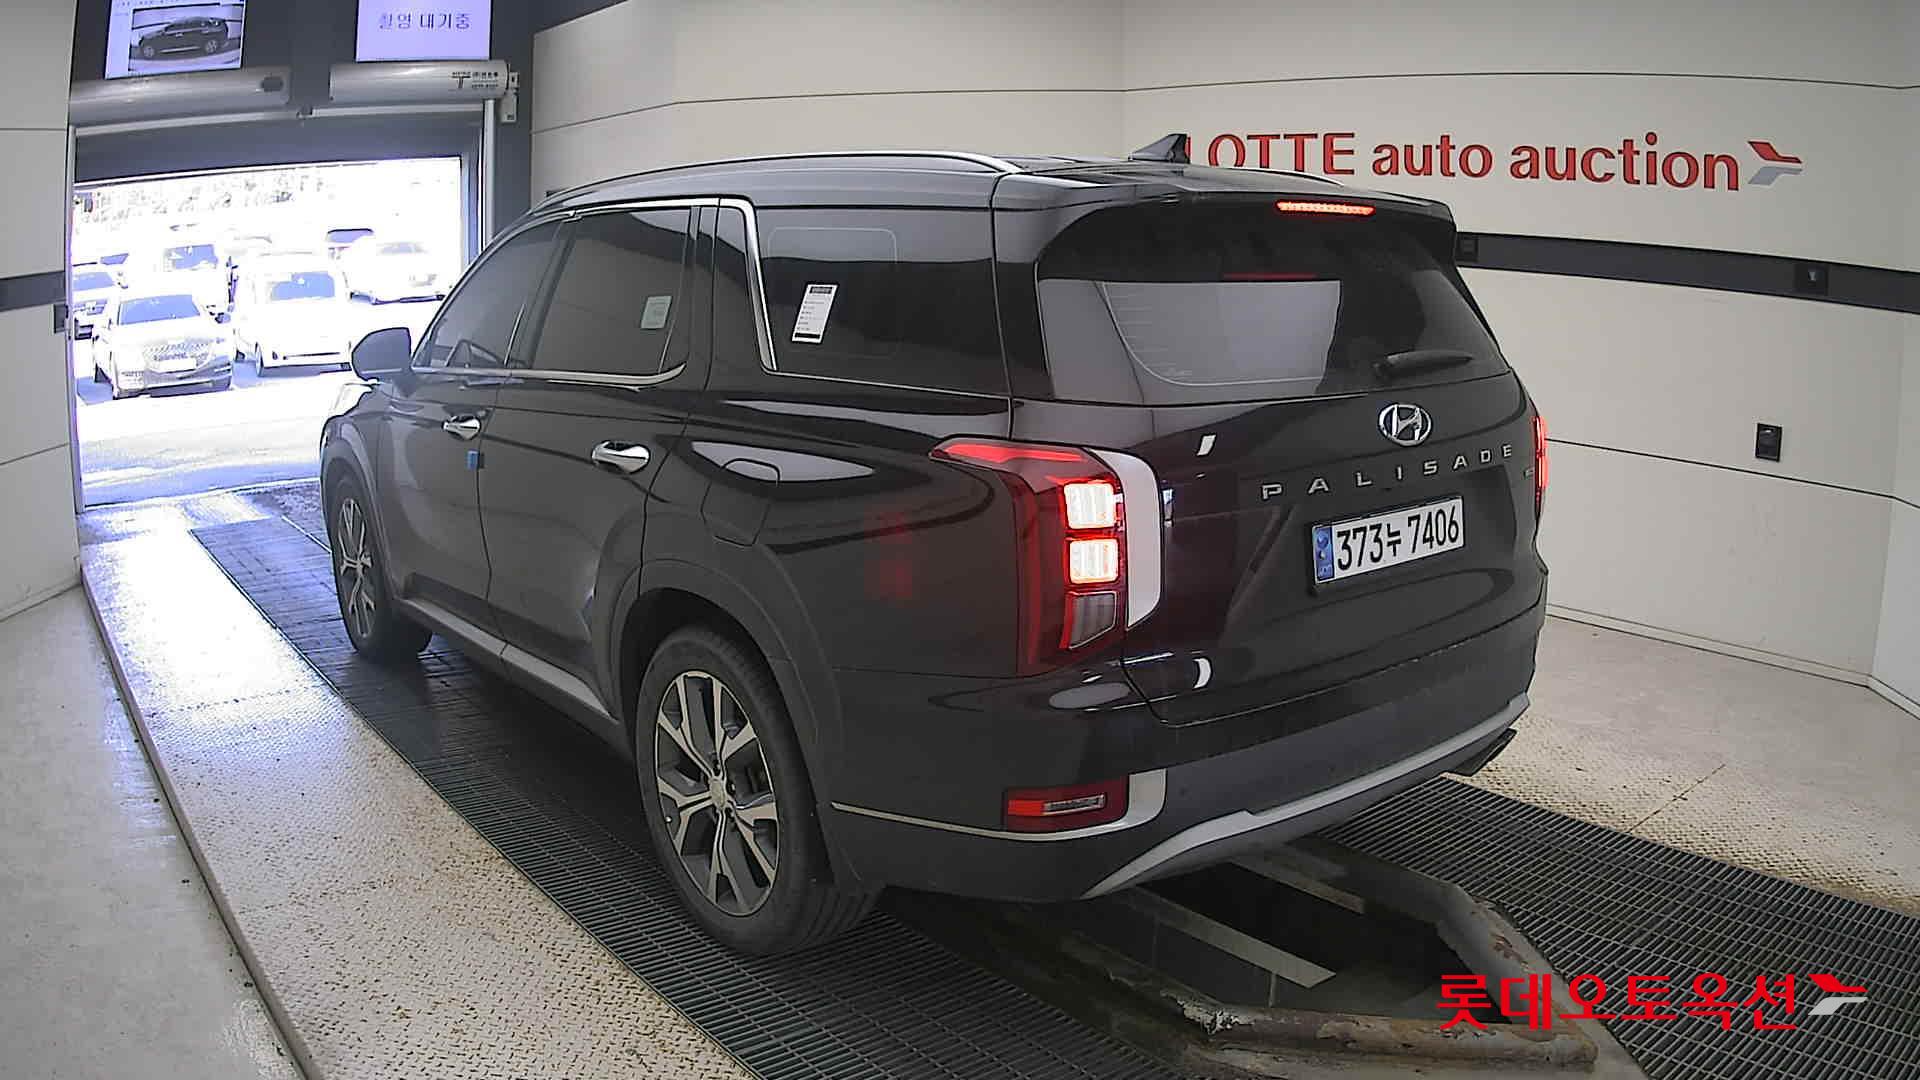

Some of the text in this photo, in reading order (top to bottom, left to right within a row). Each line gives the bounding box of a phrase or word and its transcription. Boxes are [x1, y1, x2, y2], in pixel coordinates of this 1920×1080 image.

[419, 13, 469, 30] 대기중
[1184, 132, 1740, 191] OTTE auto auction
[1261, 444, 1513, 500] PALISADE
[1407, 505, 1459, 553] 7406
